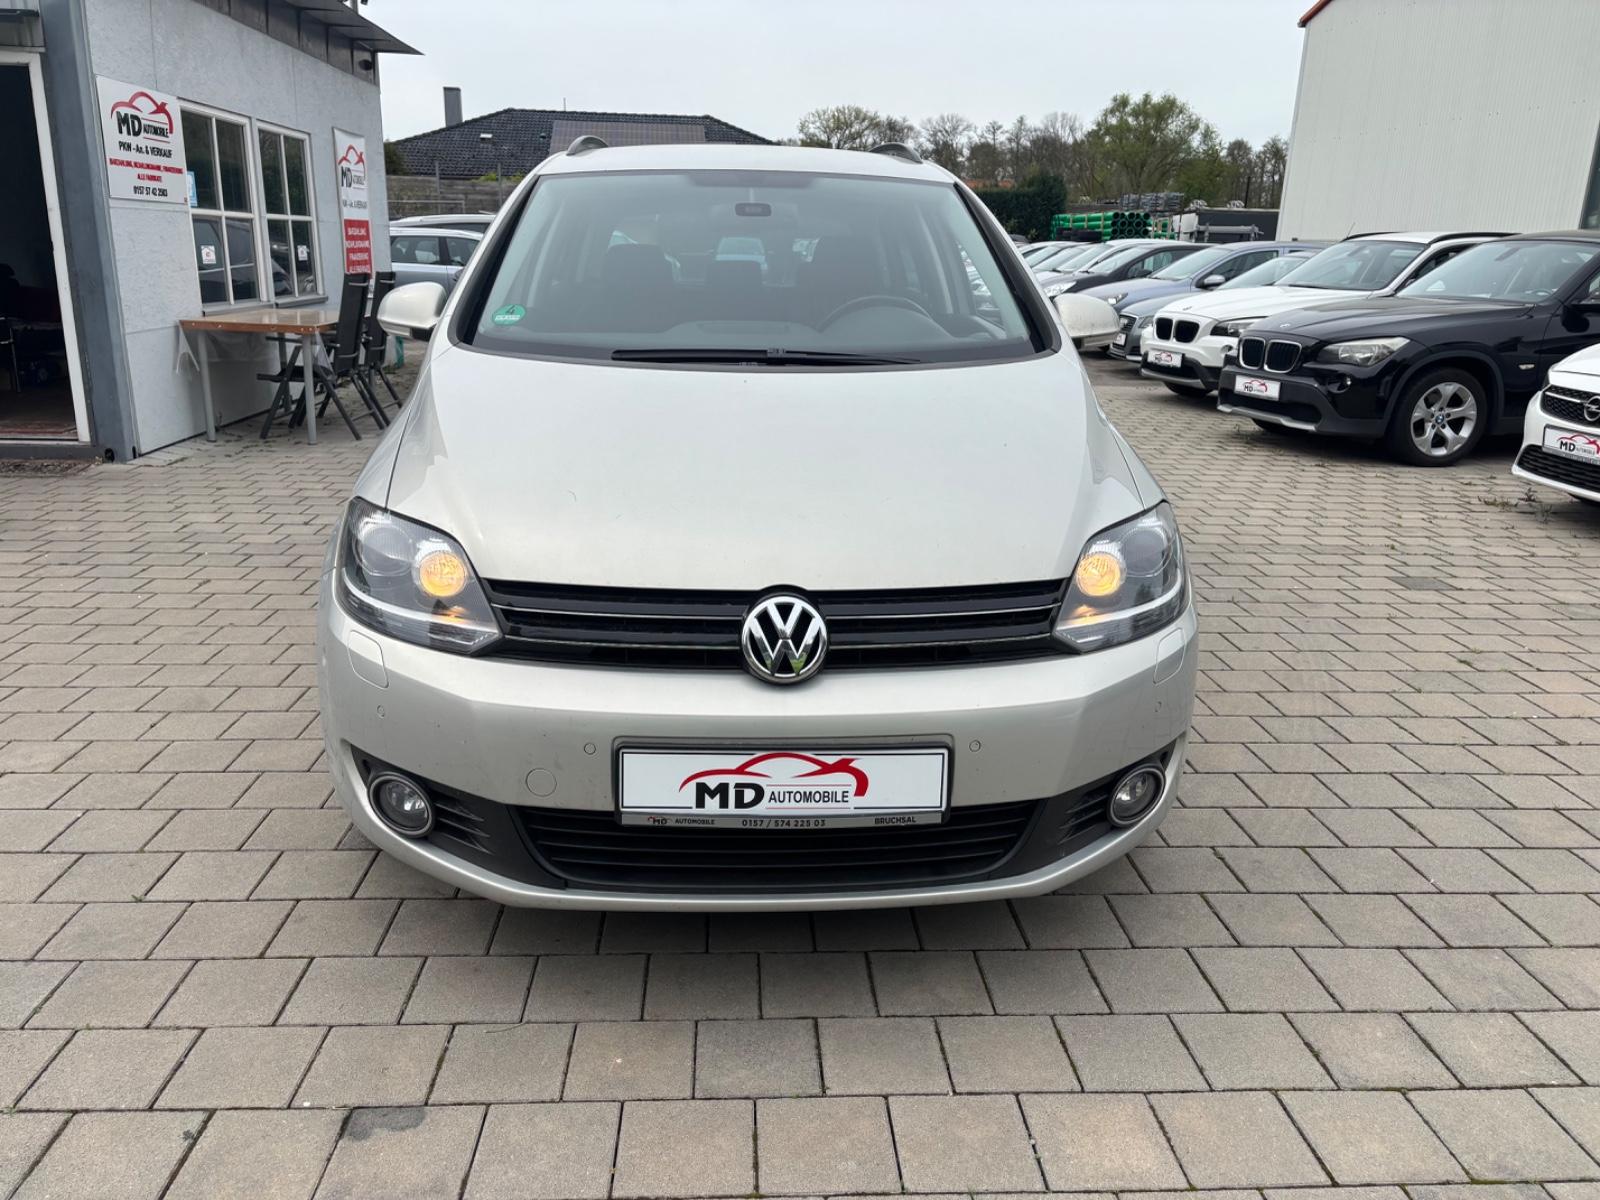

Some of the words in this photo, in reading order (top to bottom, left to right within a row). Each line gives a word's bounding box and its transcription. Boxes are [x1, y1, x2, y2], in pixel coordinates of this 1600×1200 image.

[116, 111, 142, 137] MD
[341, 166, 353, 188] MD
[1560, 440, 1576, 452] MD
[695, 782, 765, 809] MD
[768, 790, 849, 804] AUTOMOBILE
[742, 819, 763, 827] 0157
[794, 819, 811, 827] 225
[814, 819, 826, 827] 03
[874, 816, 917, 825] BRUCHSAL
